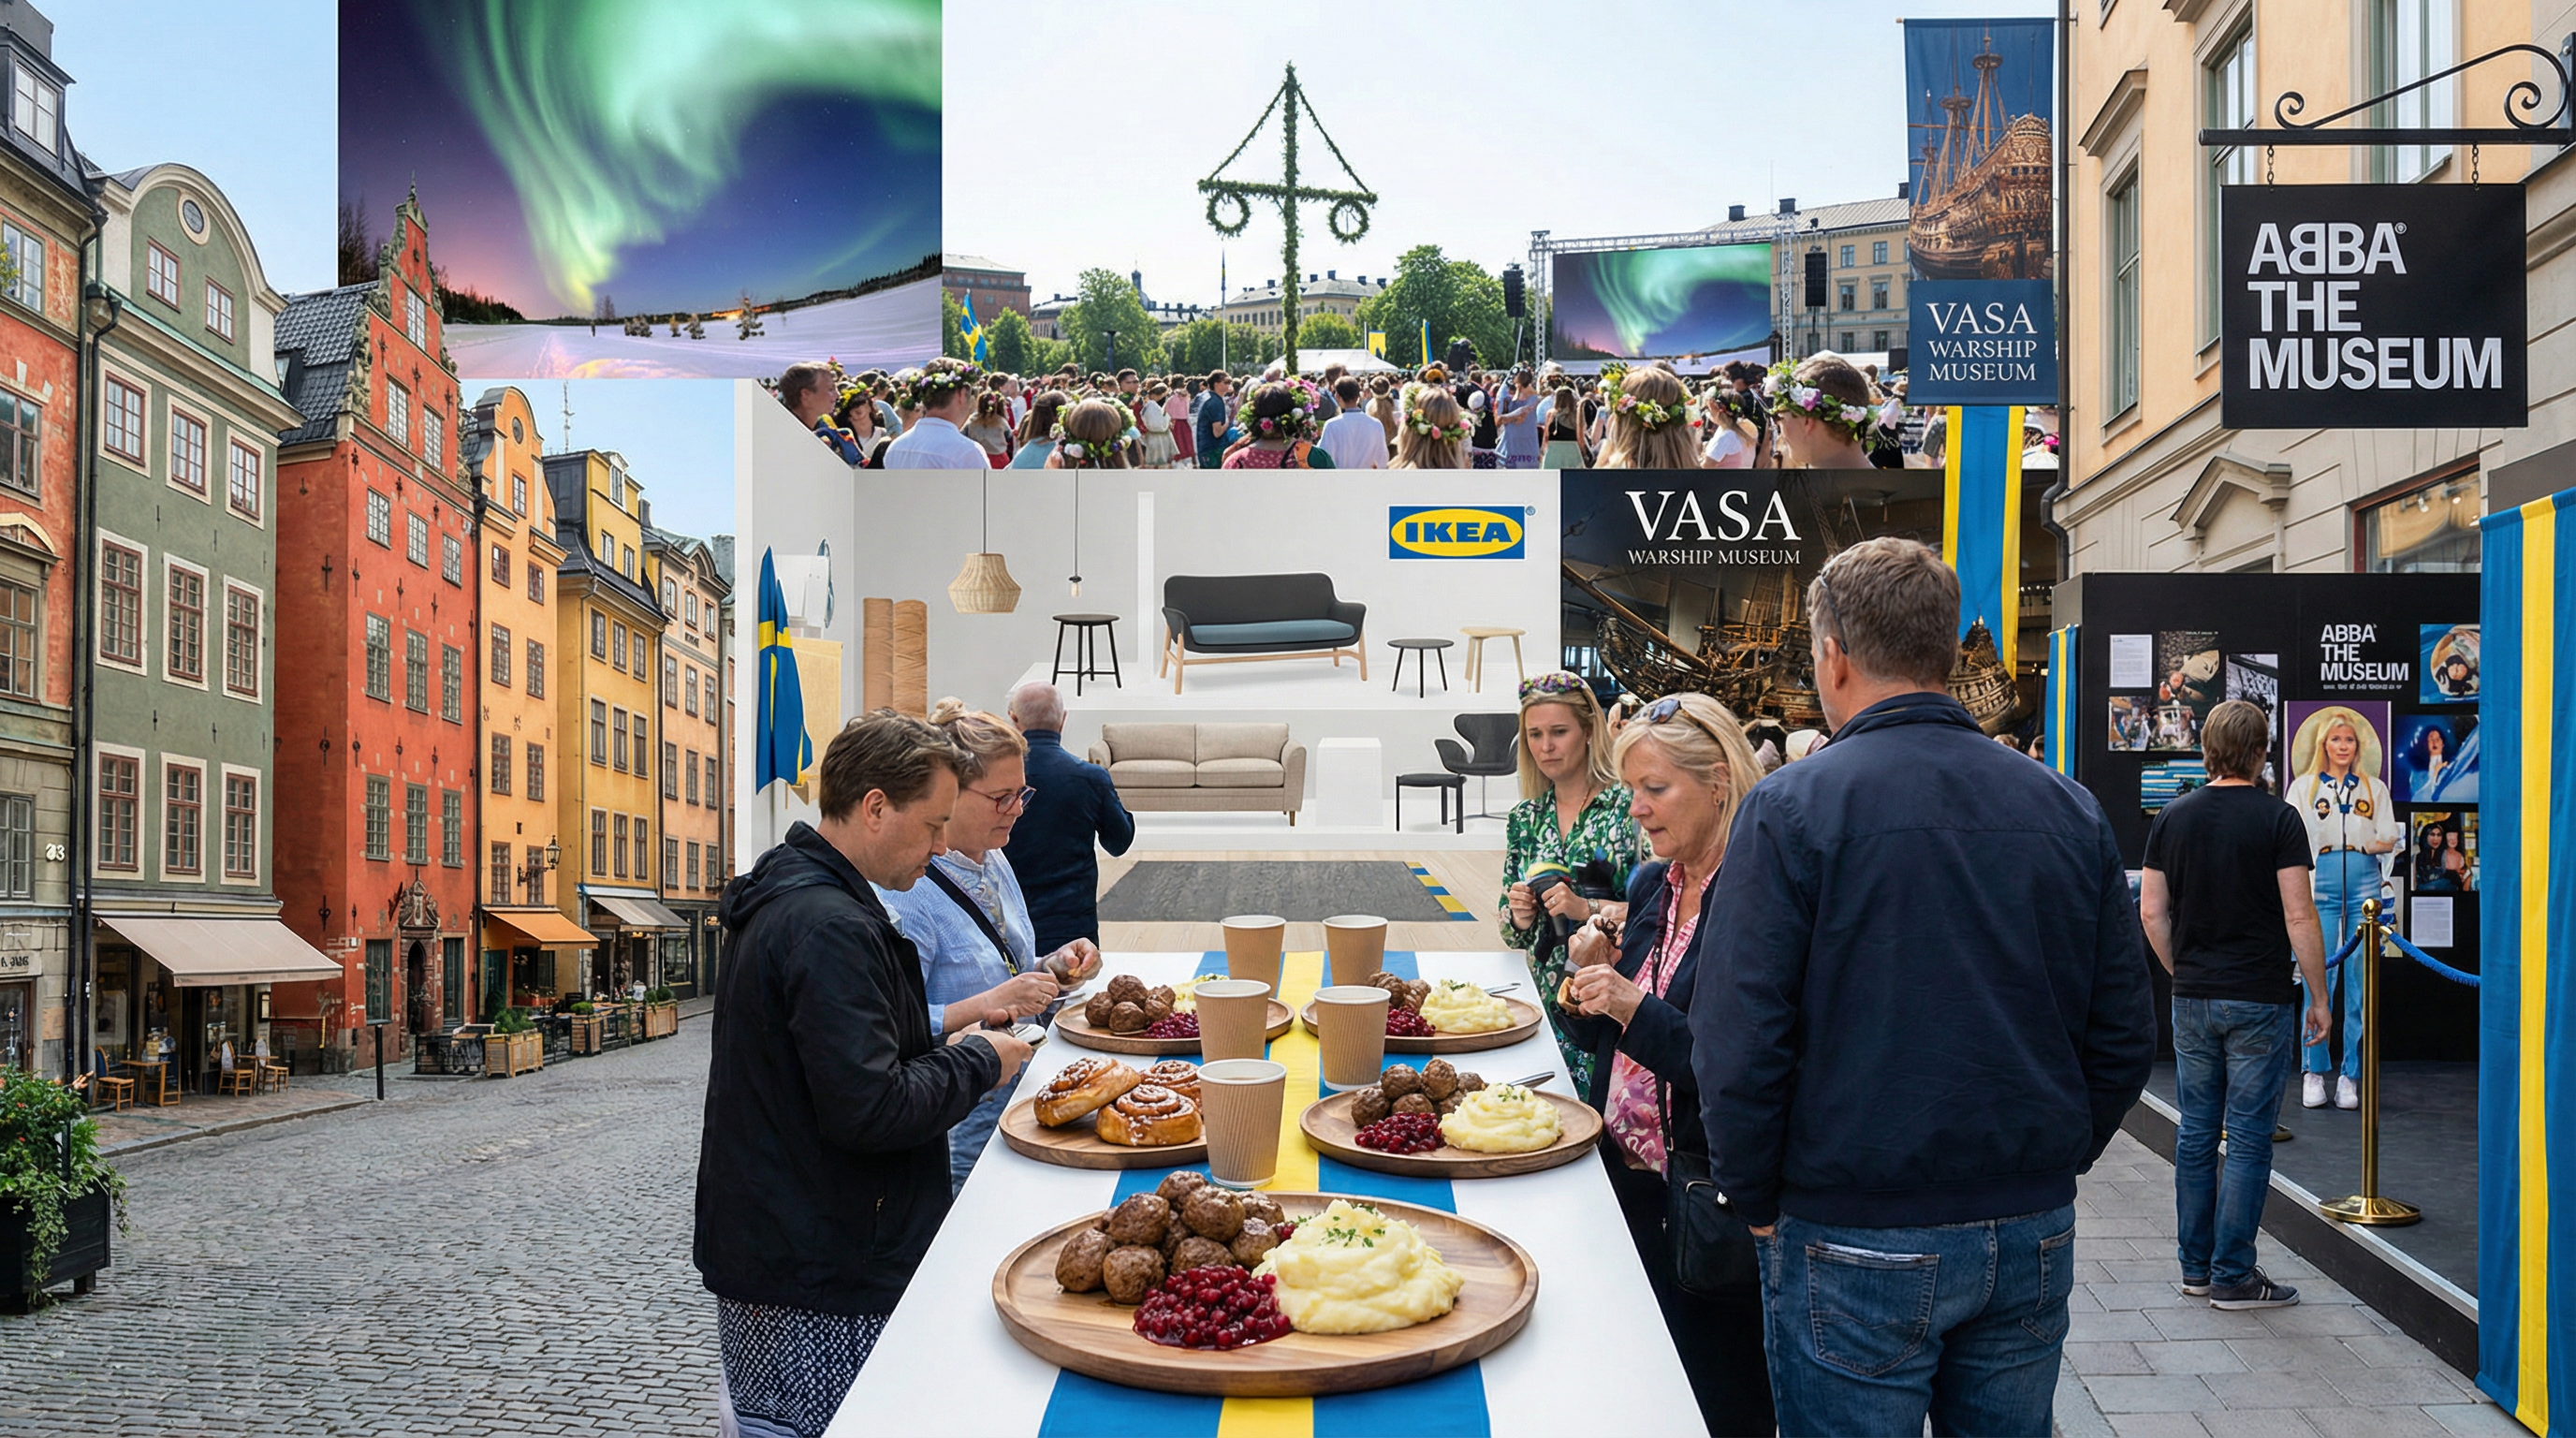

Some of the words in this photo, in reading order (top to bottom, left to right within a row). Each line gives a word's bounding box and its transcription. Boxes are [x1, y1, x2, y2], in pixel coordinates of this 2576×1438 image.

[2247, 281, 2362, 332] THE
[1926, 302, 2038, 334] VASA
[1927, 341, 2037, 359] WARSHIP
[1928, 363, 2036, 381] MUSEUM
[2248, 337, 2502, 389] MUSEUM
[1625, 490, 1802, 541] VASA
[1405, 521, 1513, 543] IKEA
[1628, 550, 1713, 565] WARSHIP
[1718, 550, 1800, 565] MUSEUM
[2320, 644, 2361, 662] THE
[2320, 663, 2409, 682] MUSEUM
